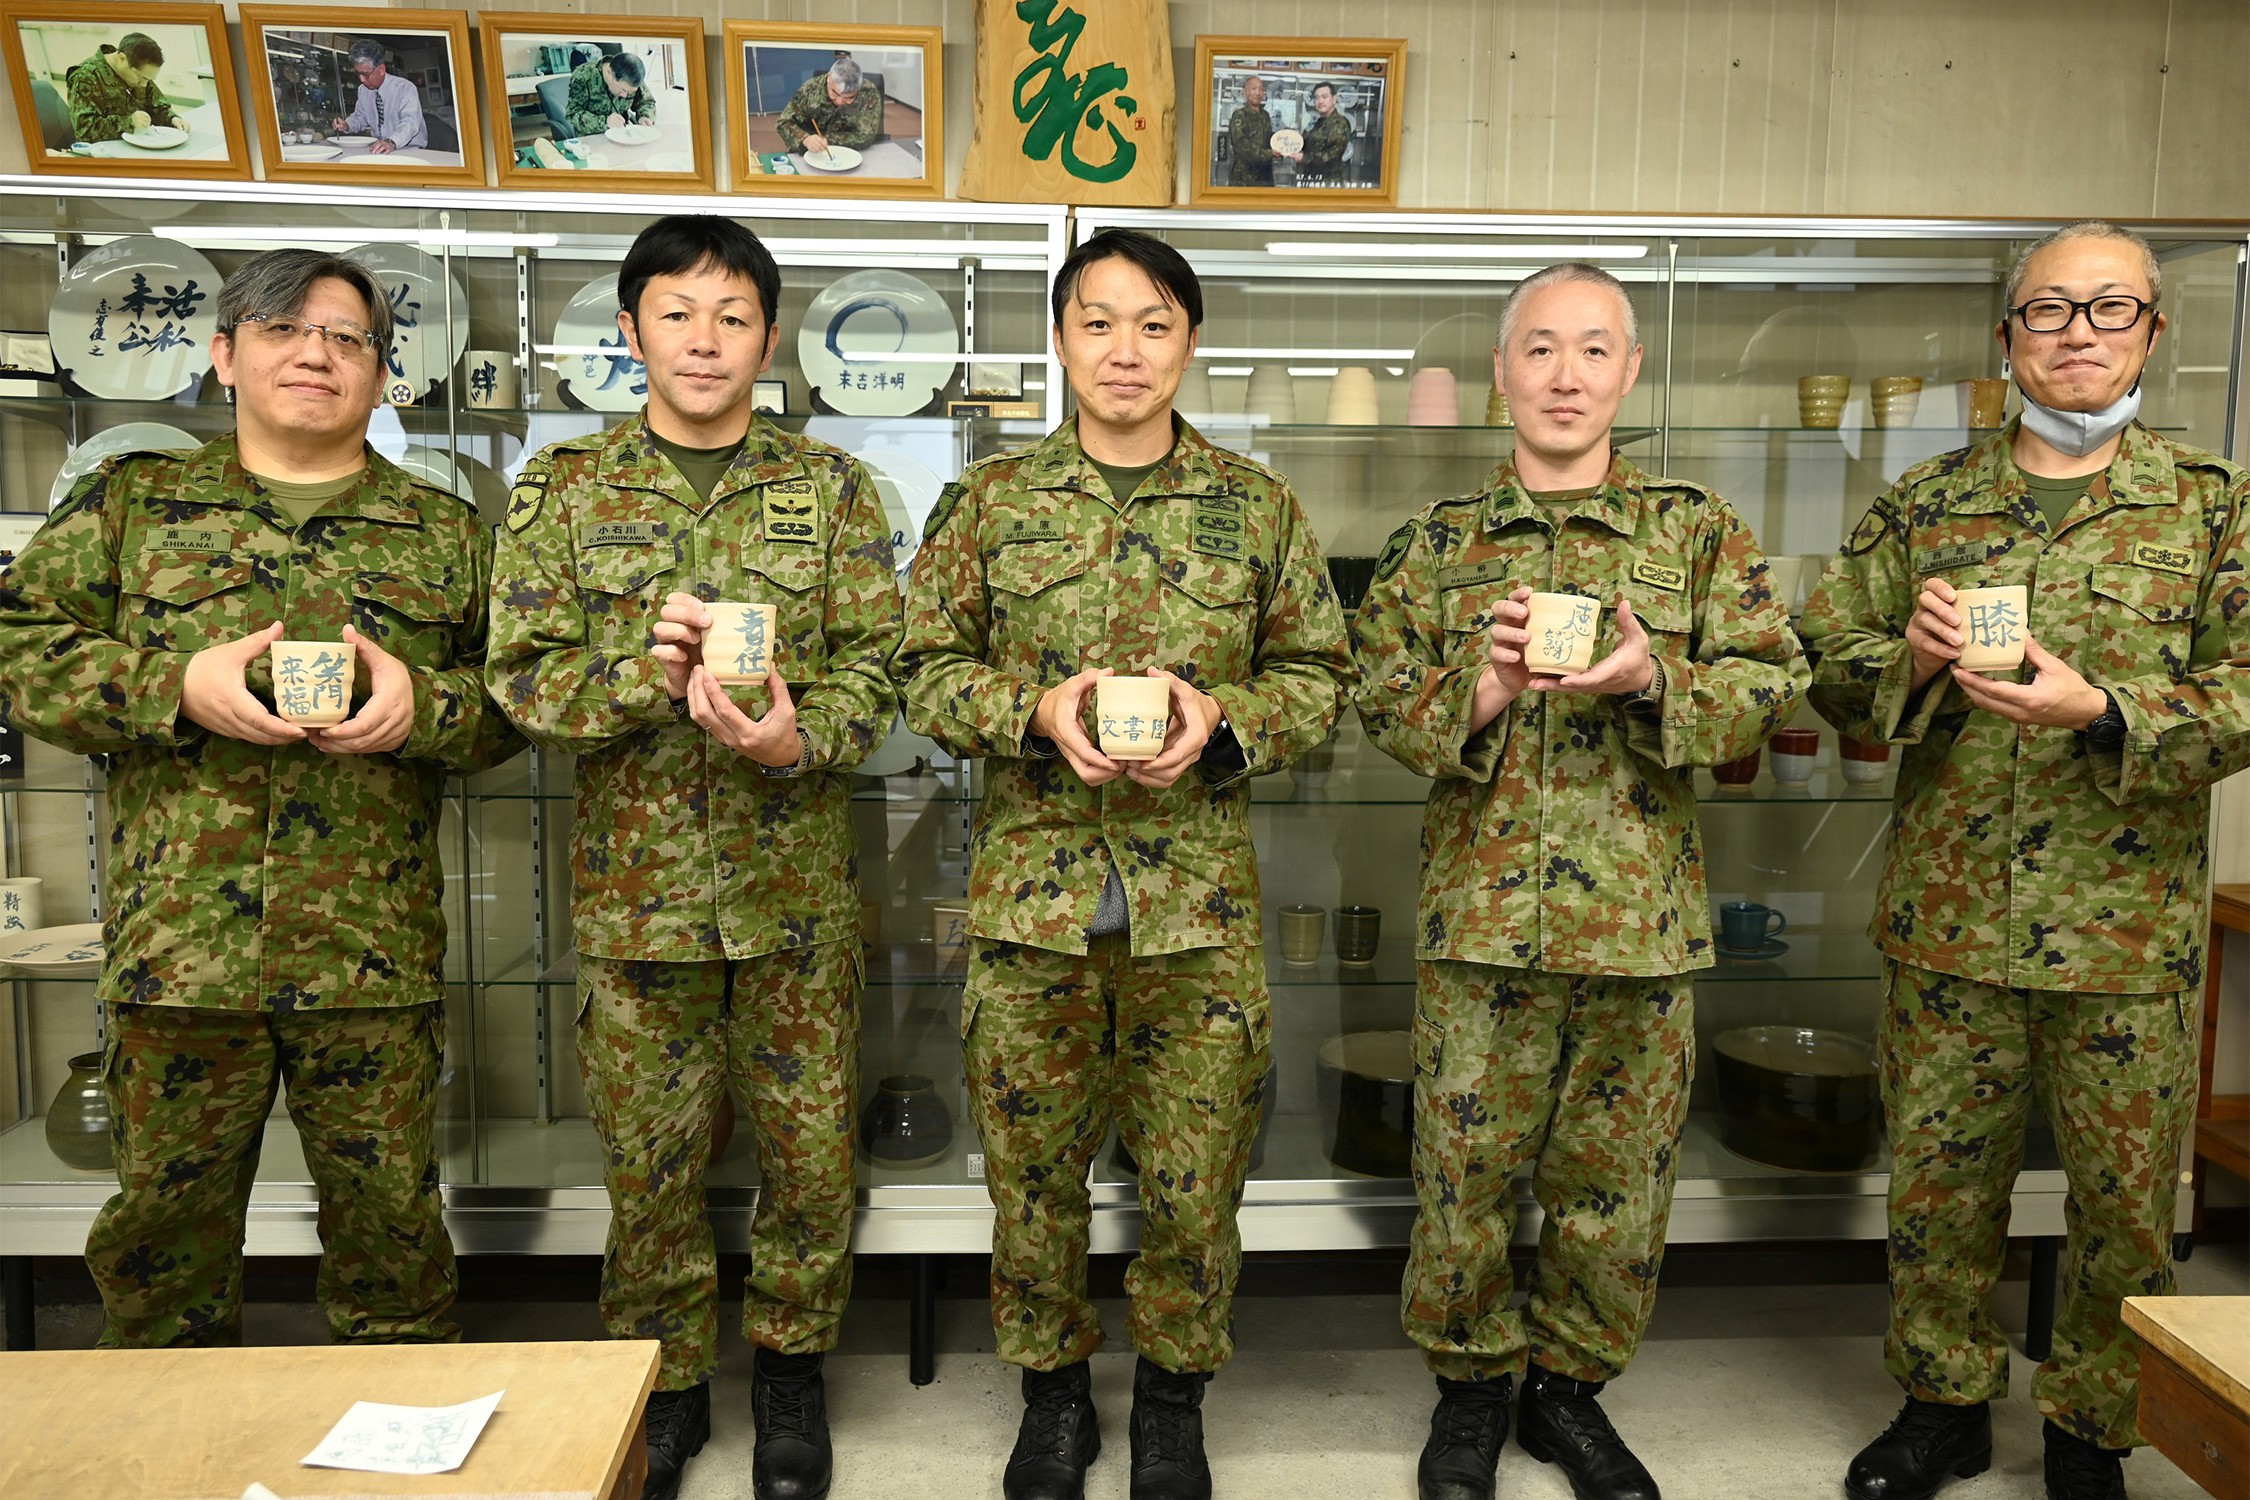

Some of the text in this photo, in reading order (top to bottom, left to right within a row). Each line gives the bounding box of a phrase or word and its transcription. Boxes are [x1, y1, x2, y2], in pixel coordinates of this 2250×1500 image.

[598, 525, 637, 534] 小石川
[1016, 530, 1058, 538] FUJIWARA
[162, 540, 215, 549] SHIKANAI
[310, 651, 348, 710] 笑門
[278, 655, 312, 717] 来福
